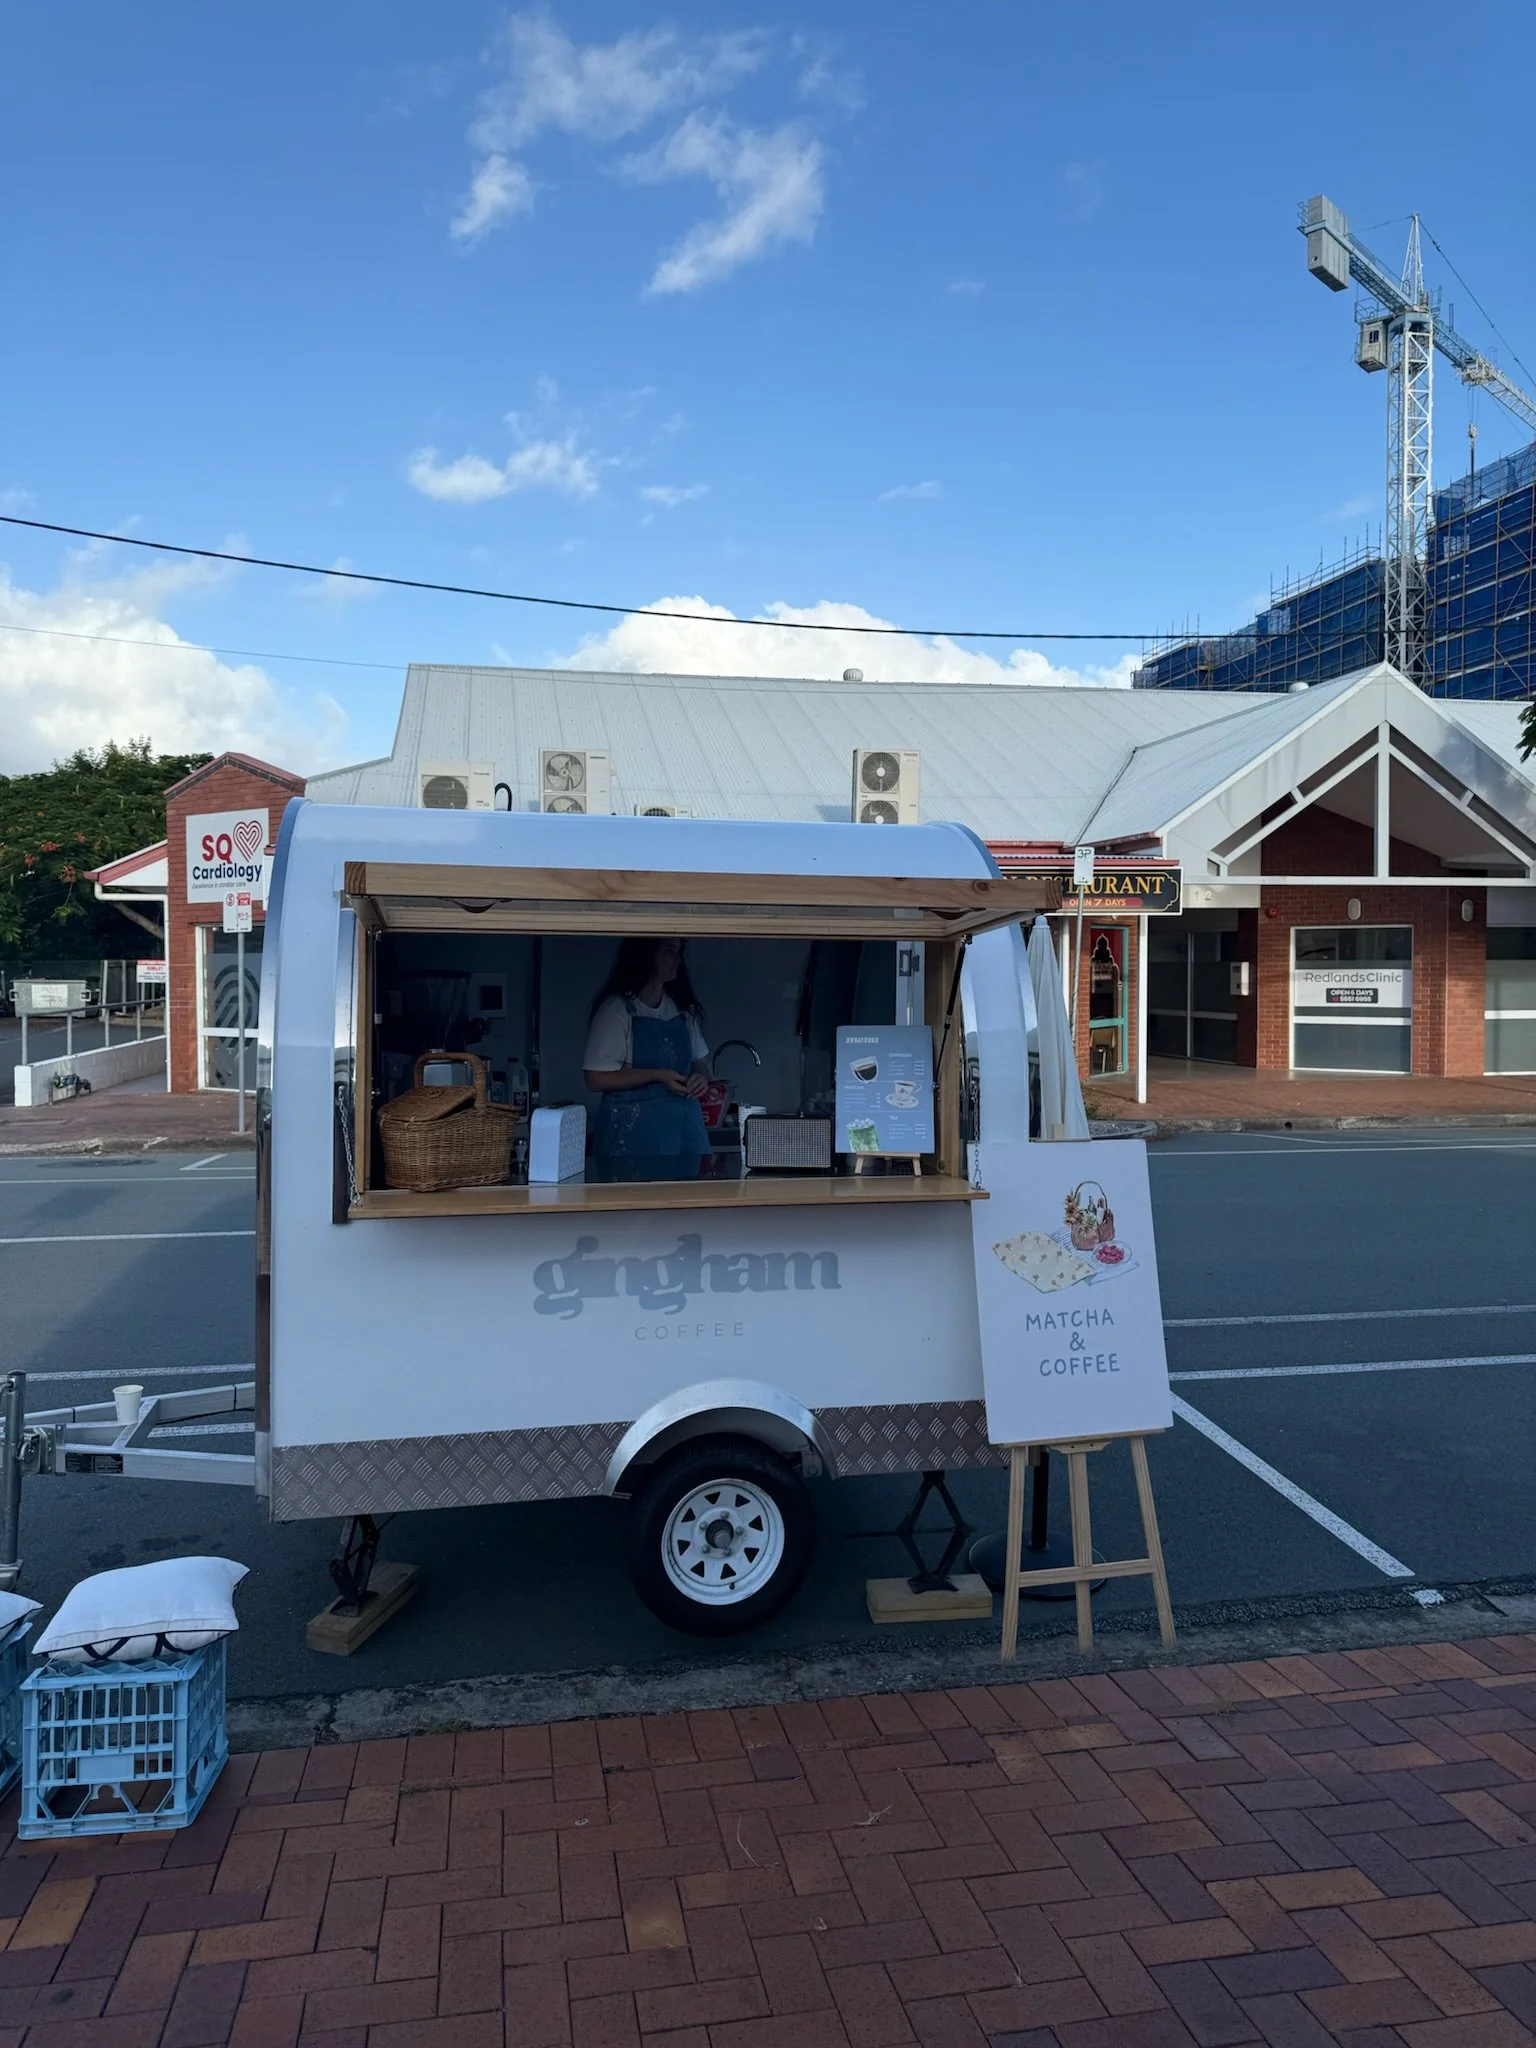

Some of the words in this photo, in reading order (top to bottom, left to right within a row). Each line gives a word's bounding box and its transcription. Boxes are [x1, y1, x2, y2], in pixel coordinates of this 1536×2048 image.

[202, 833, 232, 864] SQ
[1077, 849, 1092, 858] 3P
[192, 862, 262, 882] Cardiology
[1094, 898, 1102, 906] 7
[846, 1036, 879, 1044] menu
[533, 1234, 842, 1320] gingham
[1026, 1308, 1115, 1332] MATCHA
[634, 1322, 745, 1341] COFFEE
[1069, 1331, 1086, 1352] &
[1039, 1353, 1120, 1377] COFFEE
